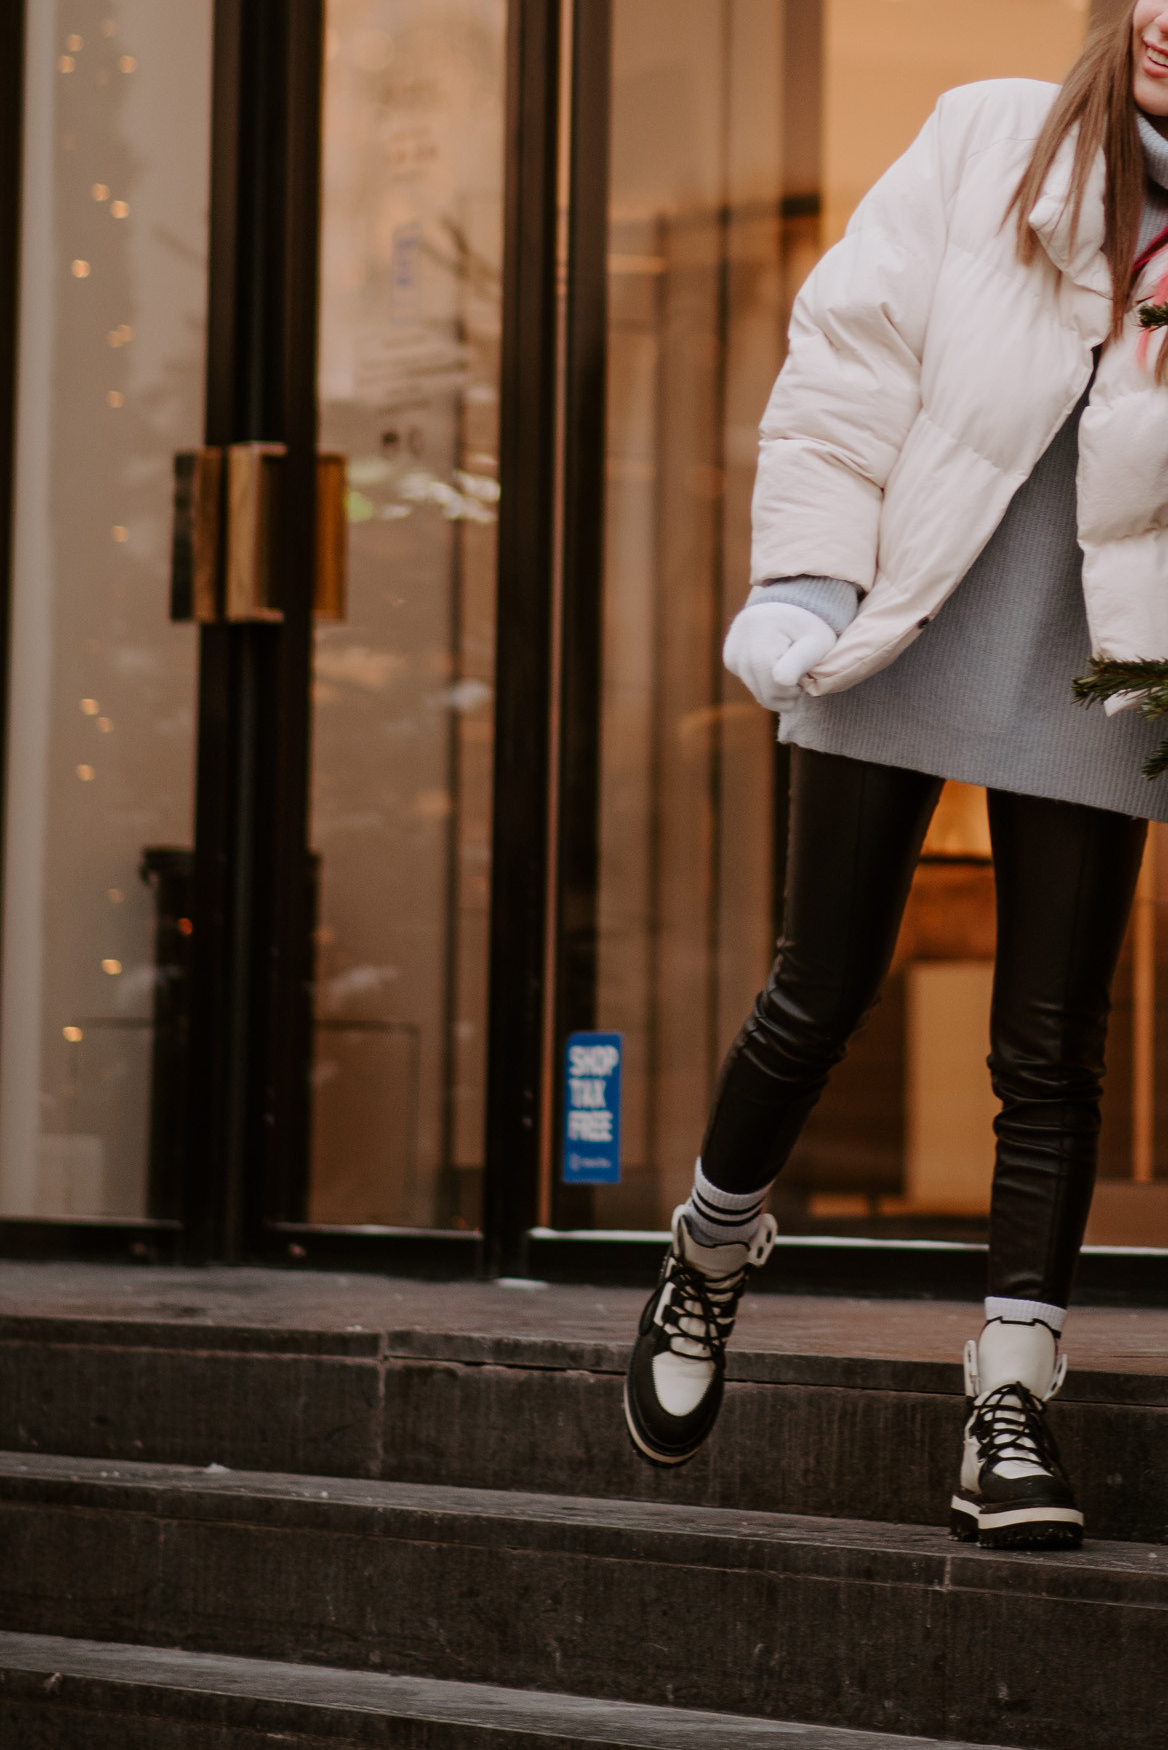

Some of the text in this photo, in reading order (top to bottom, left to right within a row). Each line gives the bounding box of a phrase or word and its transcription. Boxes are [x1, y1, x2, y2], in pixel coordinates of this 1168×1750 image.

[569, 1045, 619, 1076] SHOP
[568, 1078, 606, 1108] TAX
[568, 1110, 613, 1142] FREE
